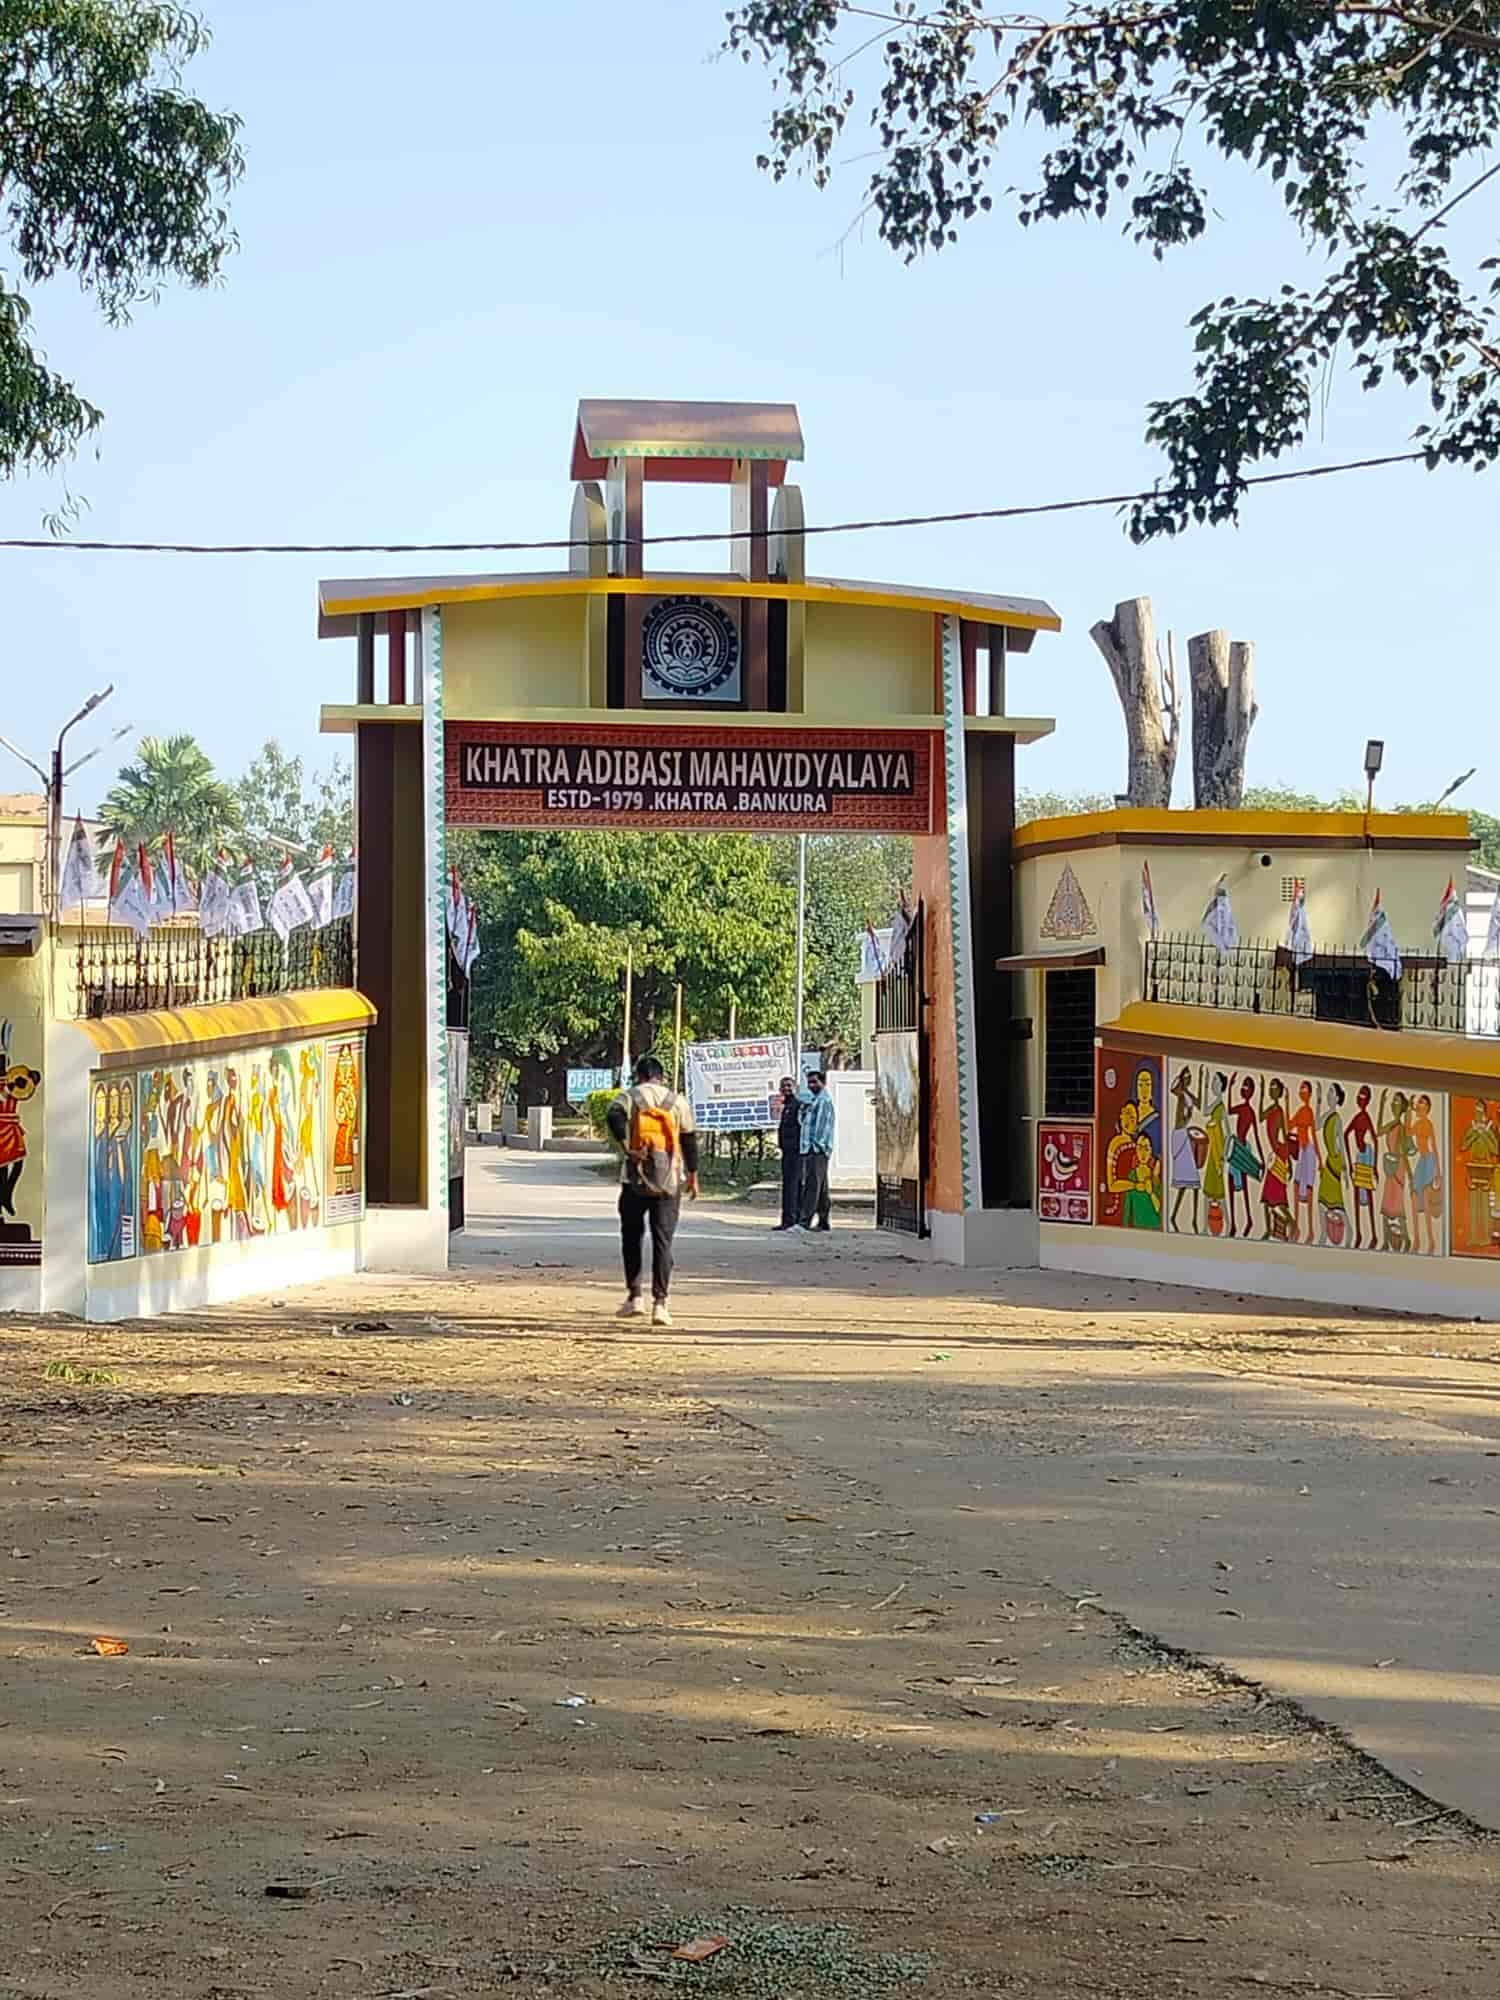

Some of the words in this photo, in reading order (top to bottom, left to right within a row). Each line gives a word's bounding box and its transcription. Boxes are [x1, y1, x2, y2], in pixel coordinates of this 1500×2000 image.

[466, 747, 570, 784] KHATRA
[575, 749, 682, 786] ADIBASI
[689, 751, 910, 789] MAHAVIDYALAYA
[548, 789, 643, 810] ESTD-1979
[567, 1072, 612, 1089] OFFICE
